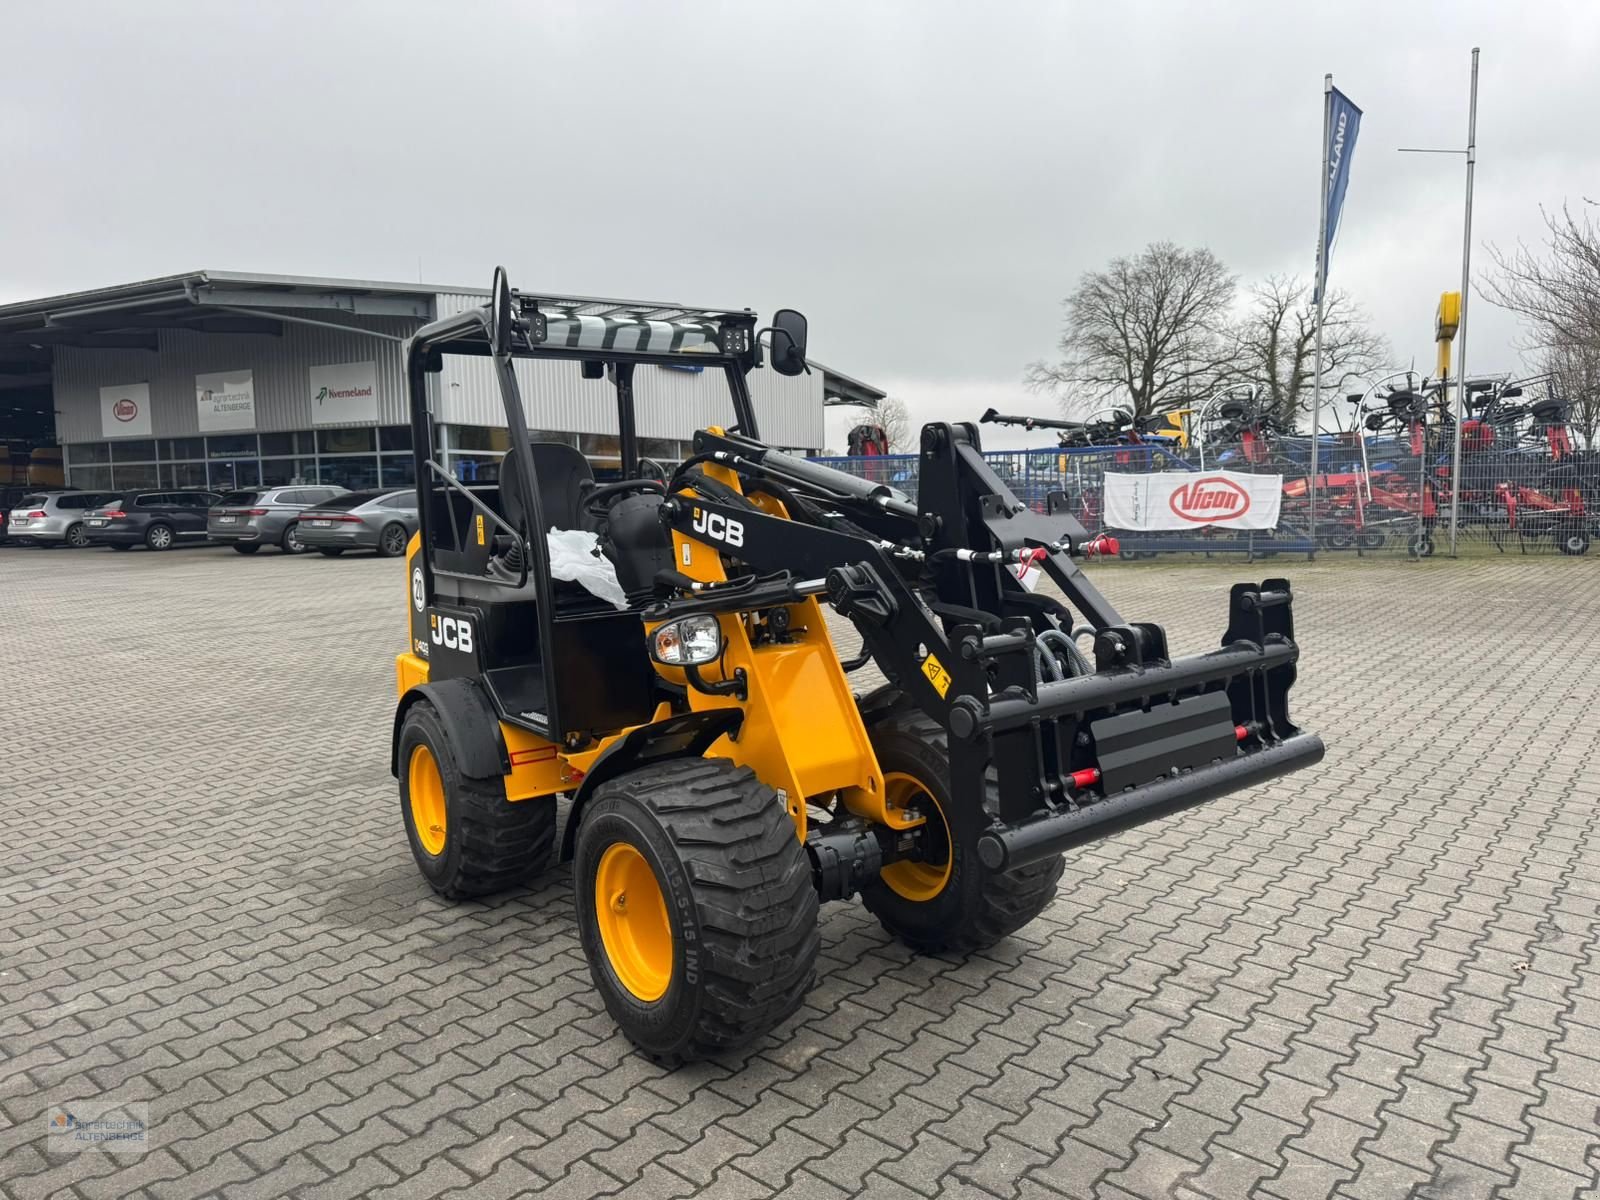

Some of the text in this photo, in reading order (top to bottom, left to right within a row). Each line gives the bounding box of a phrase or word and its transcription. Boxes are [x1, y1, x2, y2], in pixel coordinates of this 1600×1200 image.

[329, 386, 372, 399] Kverneland
[213, 402, 251, 412] ALTENBERGE
[1181, 484, 1239, 510] Vicon
[693, 508, 744, 548] JCB
[415, 578, 423, 601] 20
[431, 615, 473, 654] JCB
[685, 949, 698, 985] IND
